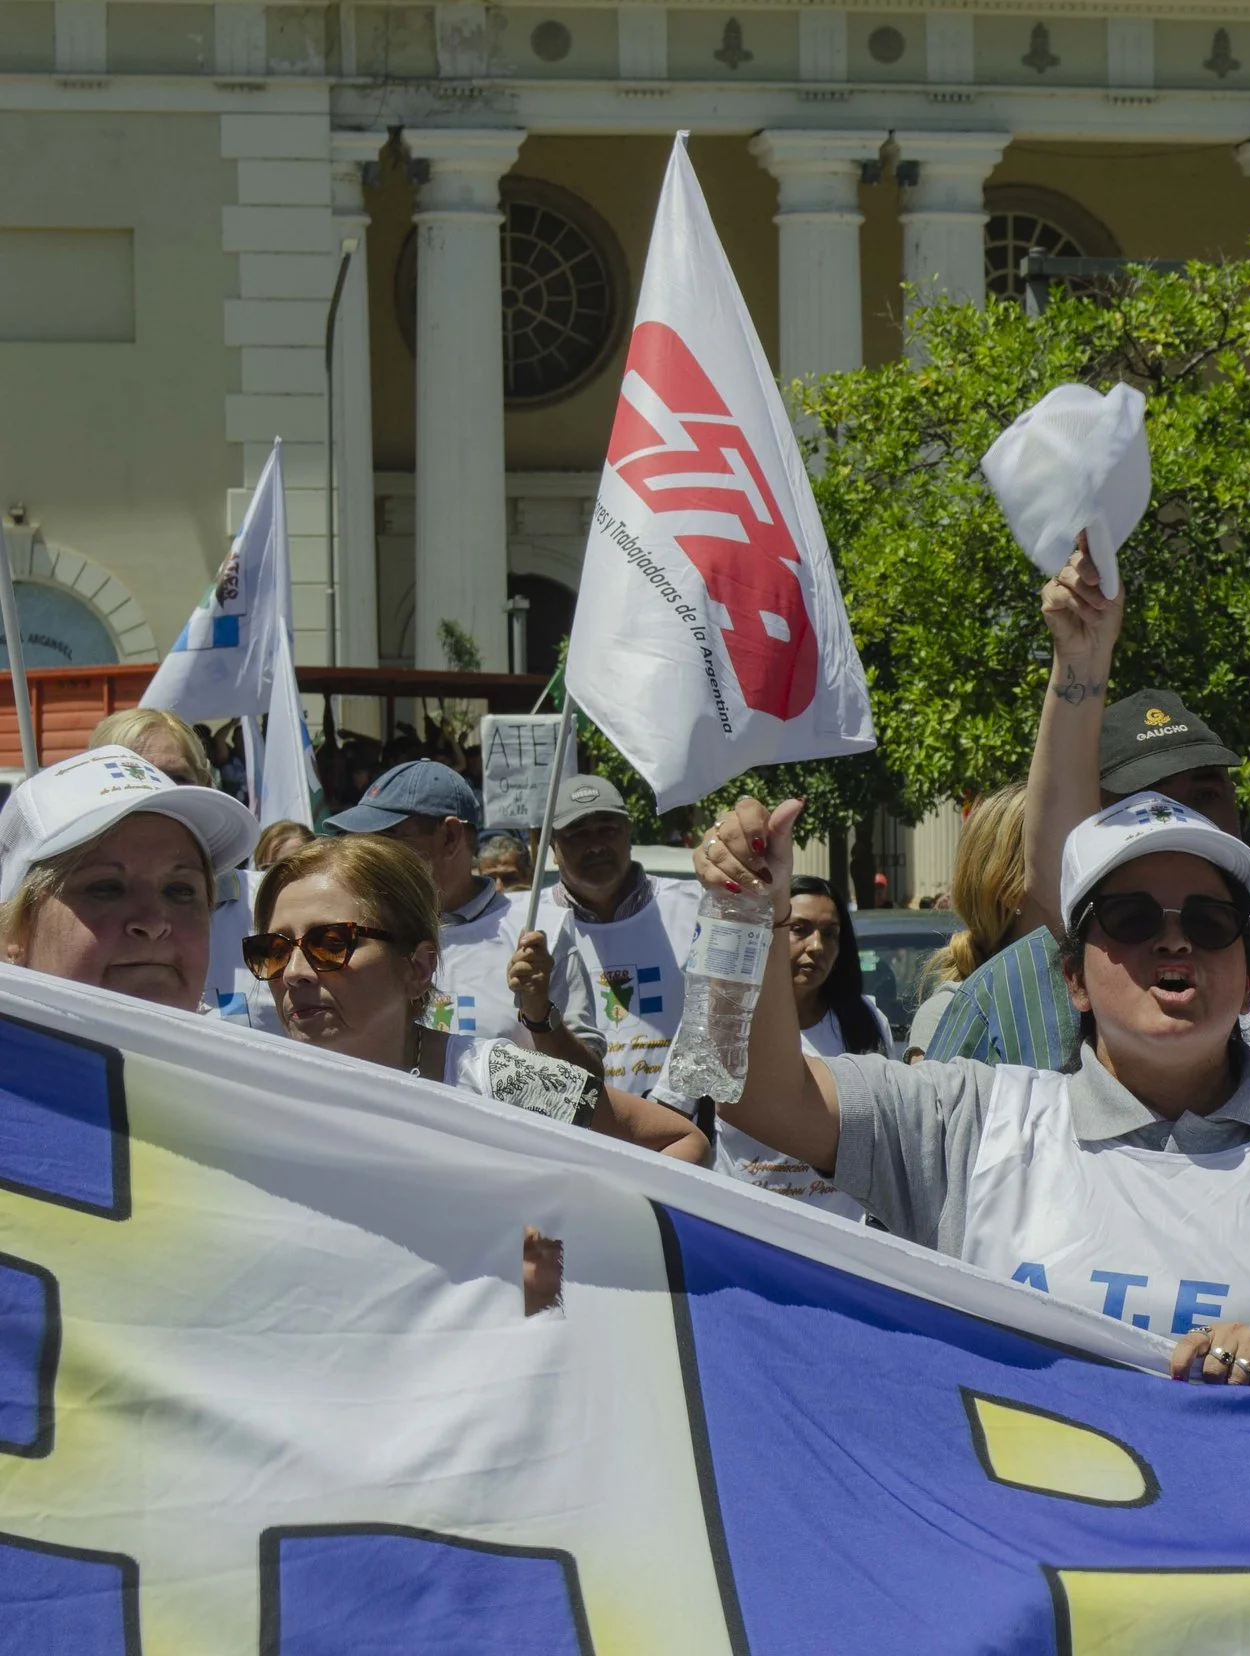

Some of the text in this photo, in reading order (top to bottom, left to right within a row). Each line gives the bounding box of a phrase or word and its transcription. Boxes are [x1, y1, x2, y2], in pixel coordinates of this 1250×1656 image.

[610, 520, 682, 603] Trabajadoras
[674, 604, 697, 623] de
[690, 626, 706, 641] la
[700, 646, 733, 733] Argentina
[1136, 724, 1188, 741] GAUCHO
